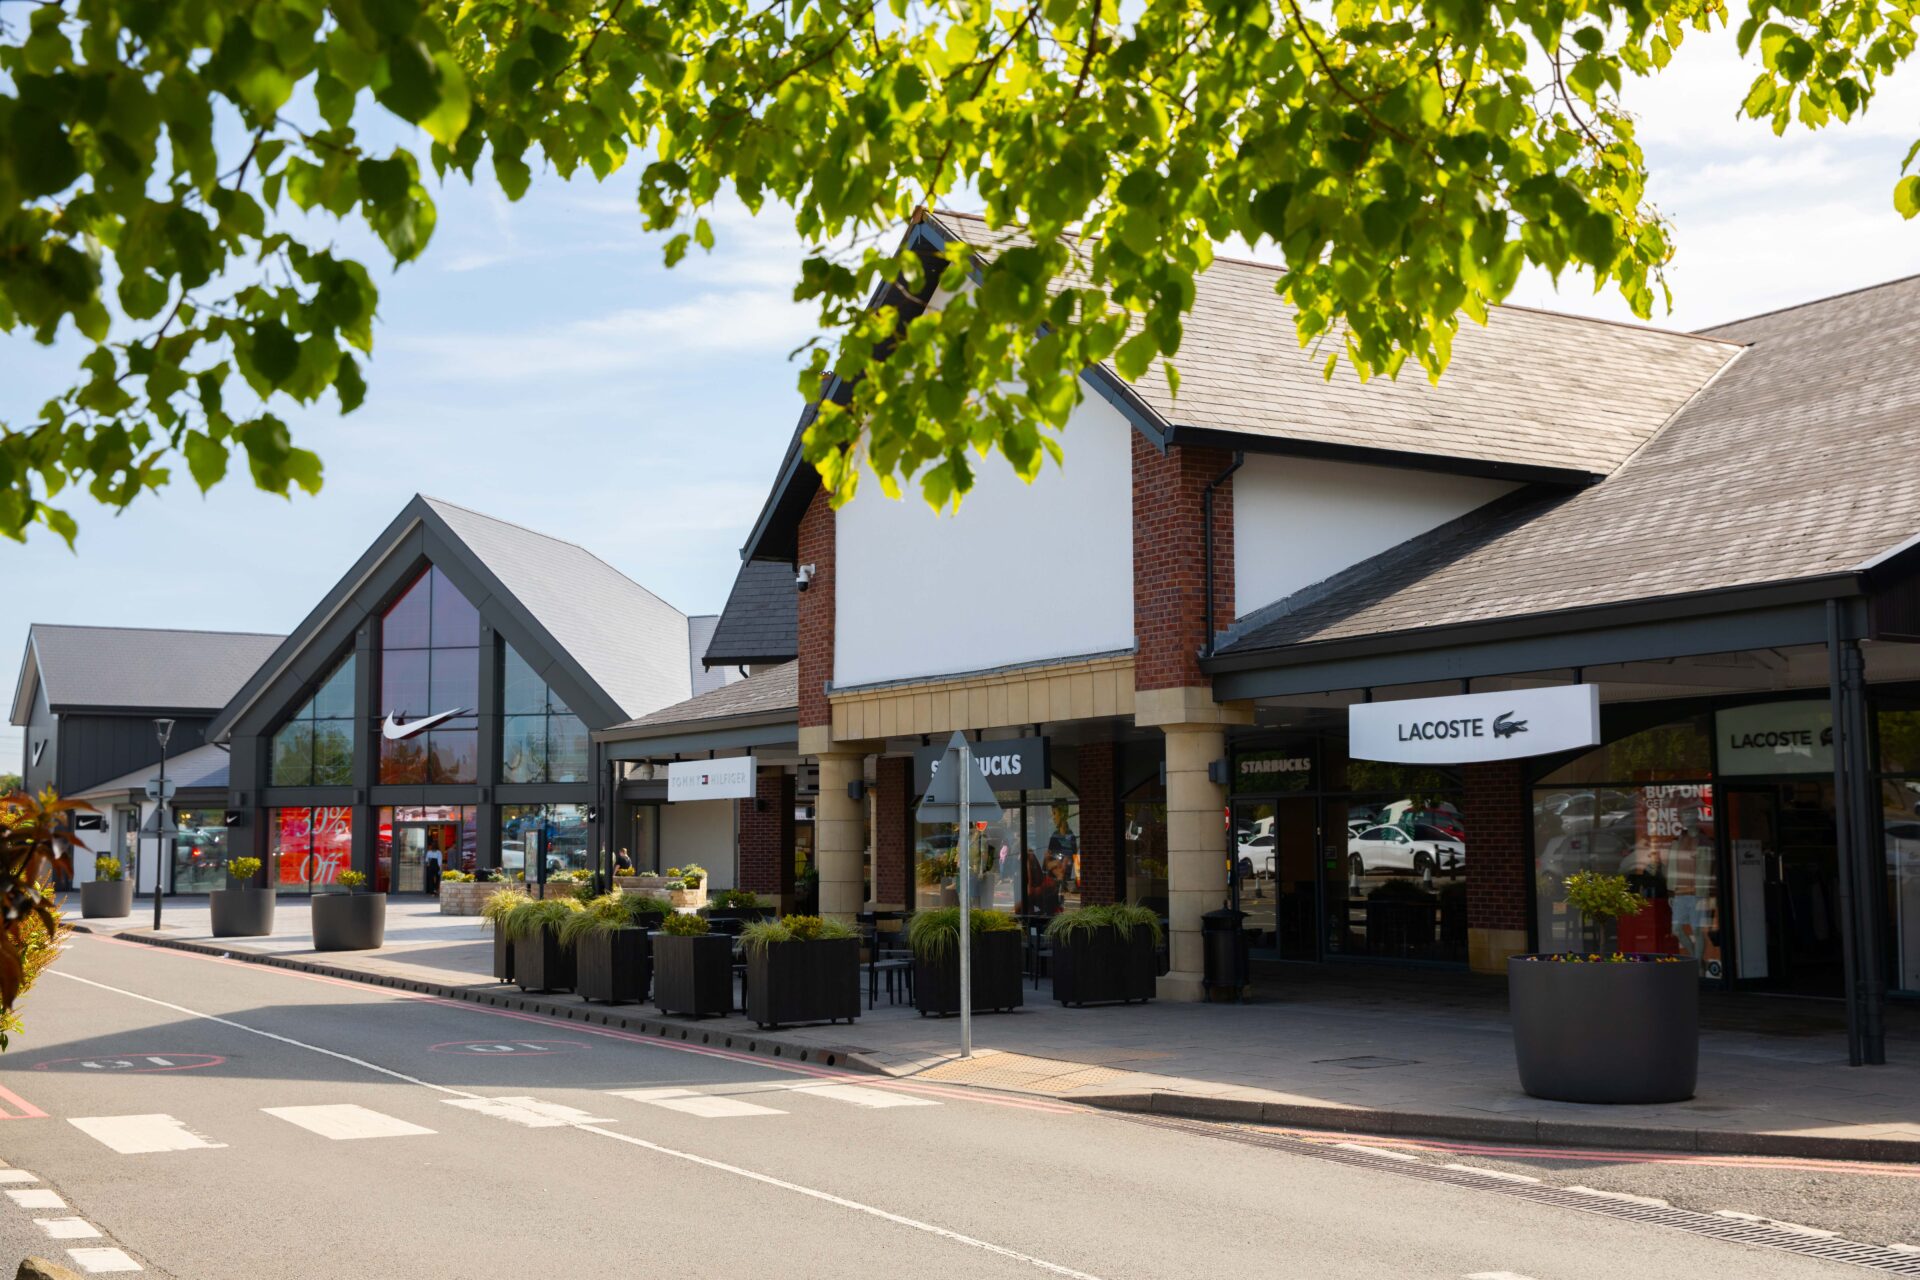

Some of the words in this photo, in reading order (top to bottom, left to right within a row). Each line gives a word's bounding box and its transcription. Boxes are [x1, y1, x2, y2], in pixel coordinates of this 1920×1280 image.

[1398, 718, 1484, 742] LACOSTE
[1730, 730, 1813, 749] LACOSTE
[930, 754, 1022, 779] SUCKS
[1240, 758, 1312, 774] STARBUCKS
[671, 776, 700, 788] TOMMY
[711, 772, 747, 785] HILFIGER
[1645, 785, 1676, 798] BUY
[1680, 784, 1713, 798] ONE
[1646, 799, 1664, 809] GET
[1647, 807, 1679, 822] ONE
[1647, 821, 1684, 836] PRIC
[300, 852, 344, 885] Off
